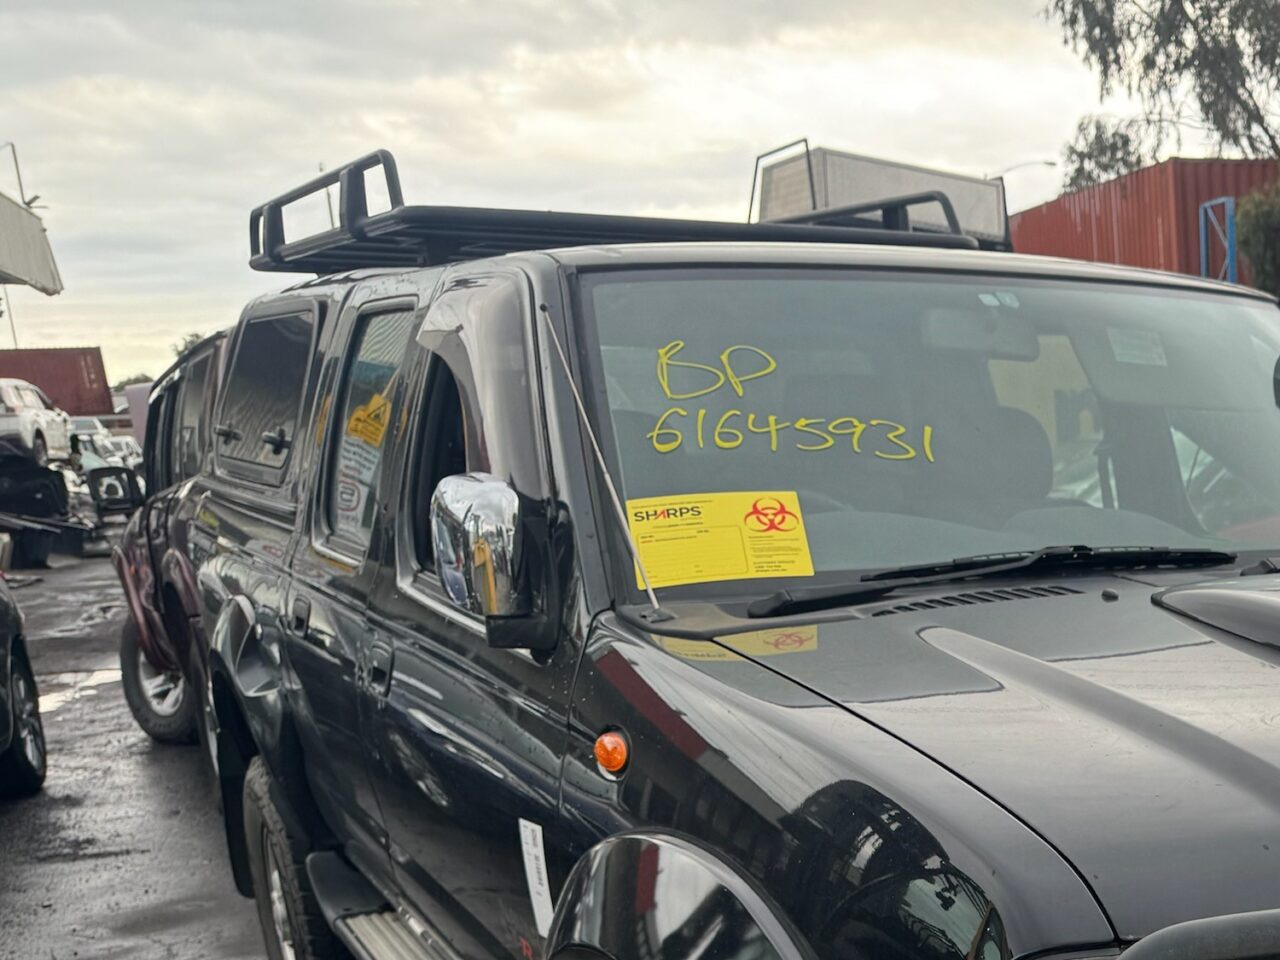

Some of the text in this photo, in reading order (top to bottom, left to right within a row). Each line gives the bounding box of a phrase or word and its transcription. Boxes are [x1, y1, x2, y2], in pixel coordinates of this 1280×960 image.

[656, 339, 777, 400] BP
[646, 407, 935, 463] 61645931
[634, 506, 702, 522] SHARPS
